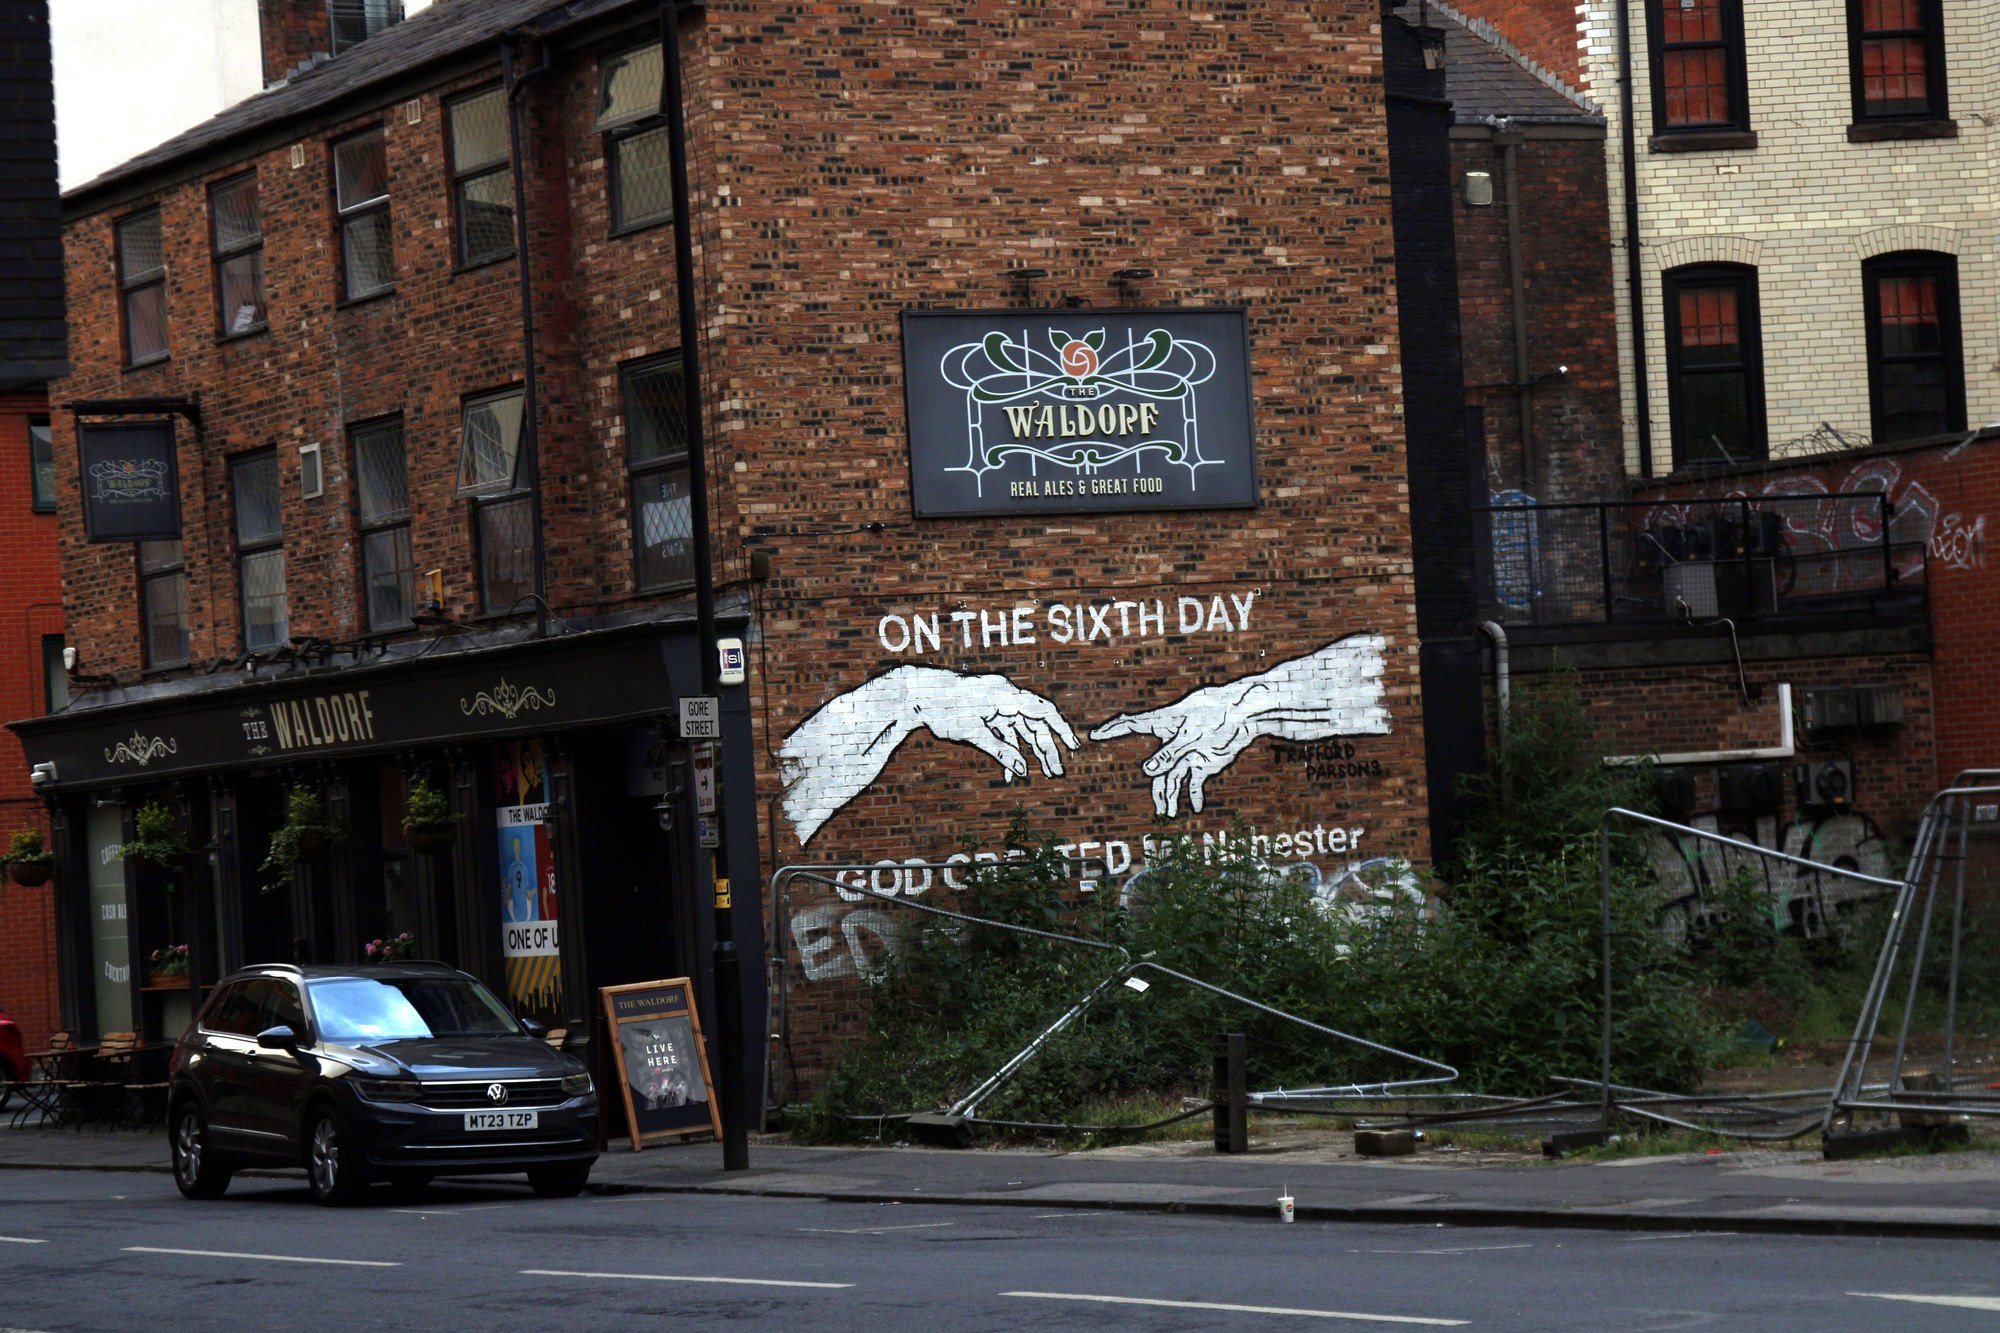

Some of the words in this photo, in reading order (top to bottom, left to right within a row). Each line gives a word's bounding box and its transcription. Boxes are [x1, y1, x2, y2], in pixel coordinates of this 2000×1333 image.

[1069, 387, 1095, 398] THE
[1002, 401, 1159, 438] WALDORF
[1010, 481, 1040, 497] REAL
[1044, 480, 1074, 496] ALES
[1078, 479, 1086, 495] &
[1091, 478, 1128, 495] GREAT
[1133, 477, 1163, 493] FOOD
[878, 612, 941, 653] ON
[951, 607, 1037, 649] THE
[1048, 600, 1165, 643] SIXTH
[1178, 591, 1254, 634] DAY
[688, 701, 709, 716] GORE
[242, 721, 268, 740] THE
[269, 690, 374, 749] WALDORF
[685, 720, 714, 735] STREET
[1305, 759, 1383, 781] PARSONS
[508, 808, 522, 823] THE
[516, 870, 522, 889] 9
[835, 858, 932, 901] GOD
[508, 928, 531, 949] ONE
[534, 928, 548, 948] OF
[618, 1000, 636, 1009] THE
[636, 994, 680, 1007] WALDORF
[646, 1042, 673, 1054] LIVE
[647, 1055, 677, 1067] HERE
[470, 1114, 504, 1128] MT23
[508, 1113, 532, 1127] TZP
